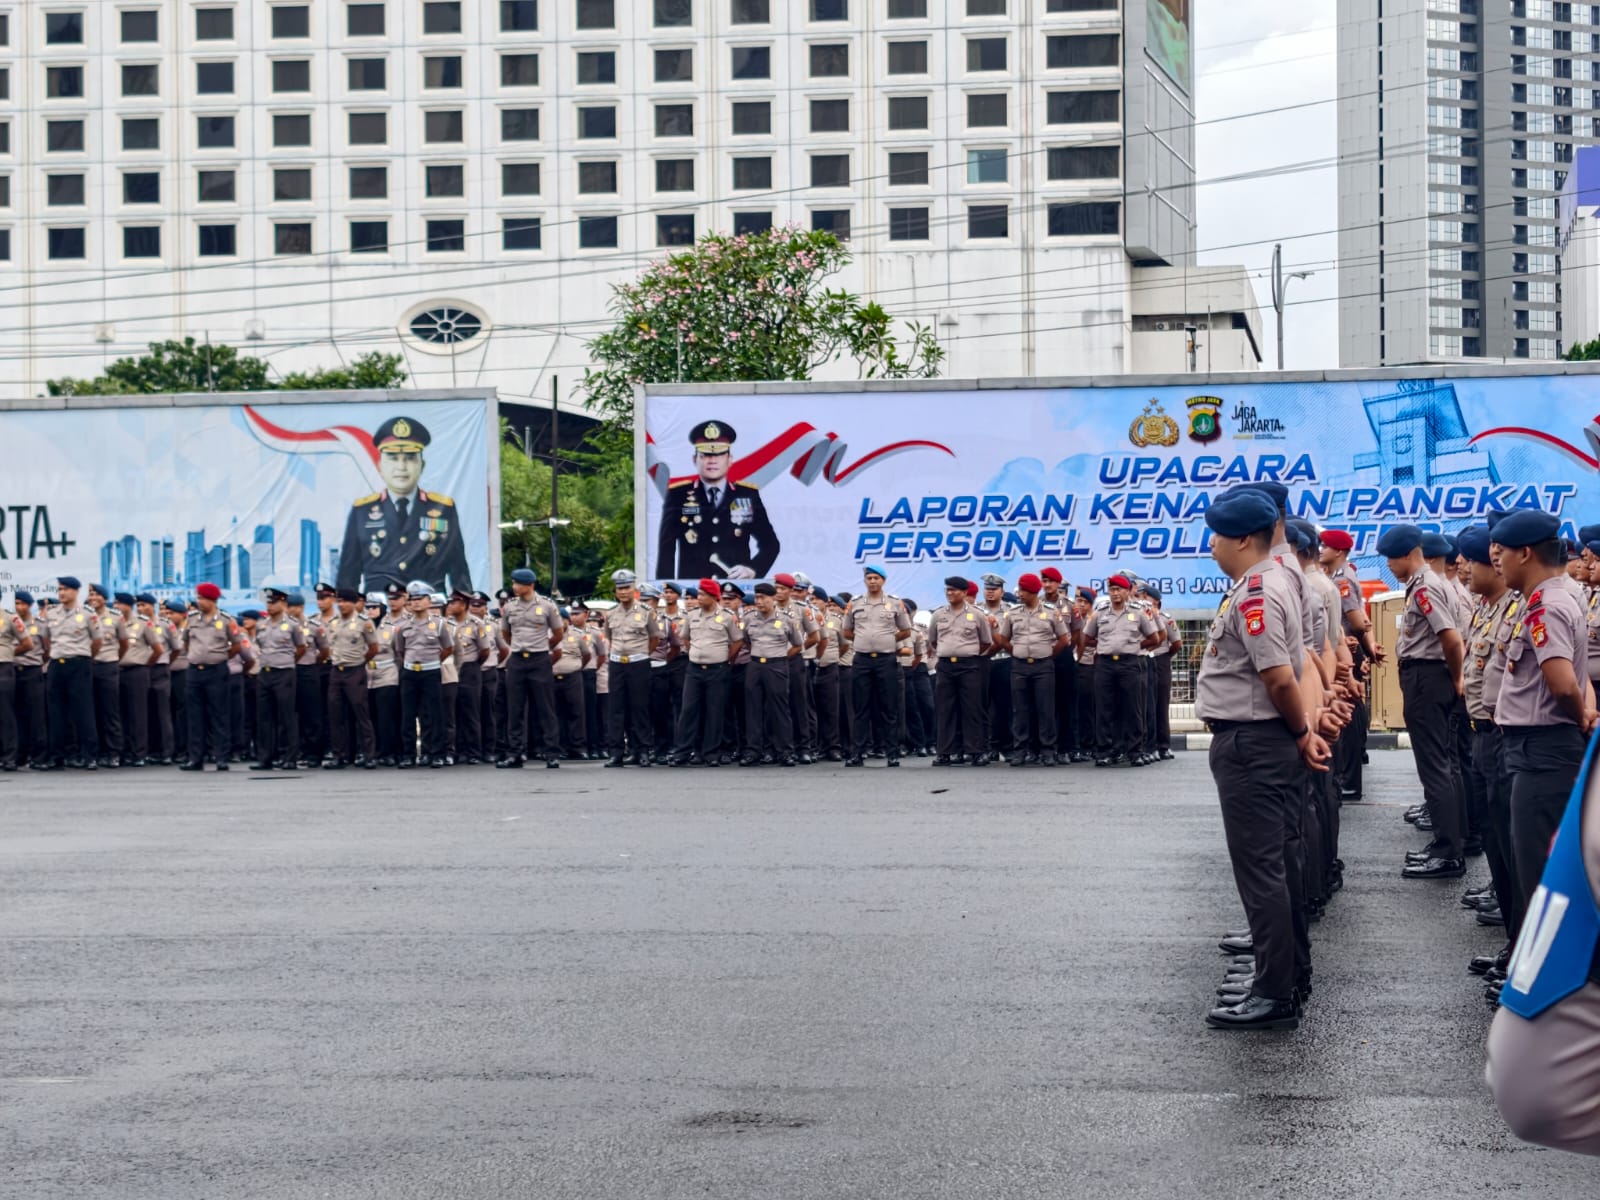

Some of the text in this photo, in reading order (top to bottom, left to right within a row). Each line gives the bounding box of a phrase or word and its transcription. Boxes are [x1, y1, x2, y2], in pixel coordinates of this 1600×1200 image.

[1231, 404, 1257, 420] JAGA
[1099, 454, 1317, 485] UPACARA
[858, 494, 1074, 525] LAPORAN
[1347, 485, 1574, 516] PANGKAT
[854, 529, 1091, 560] PERSONEL
[1176, 578, 1186, 594] 1
